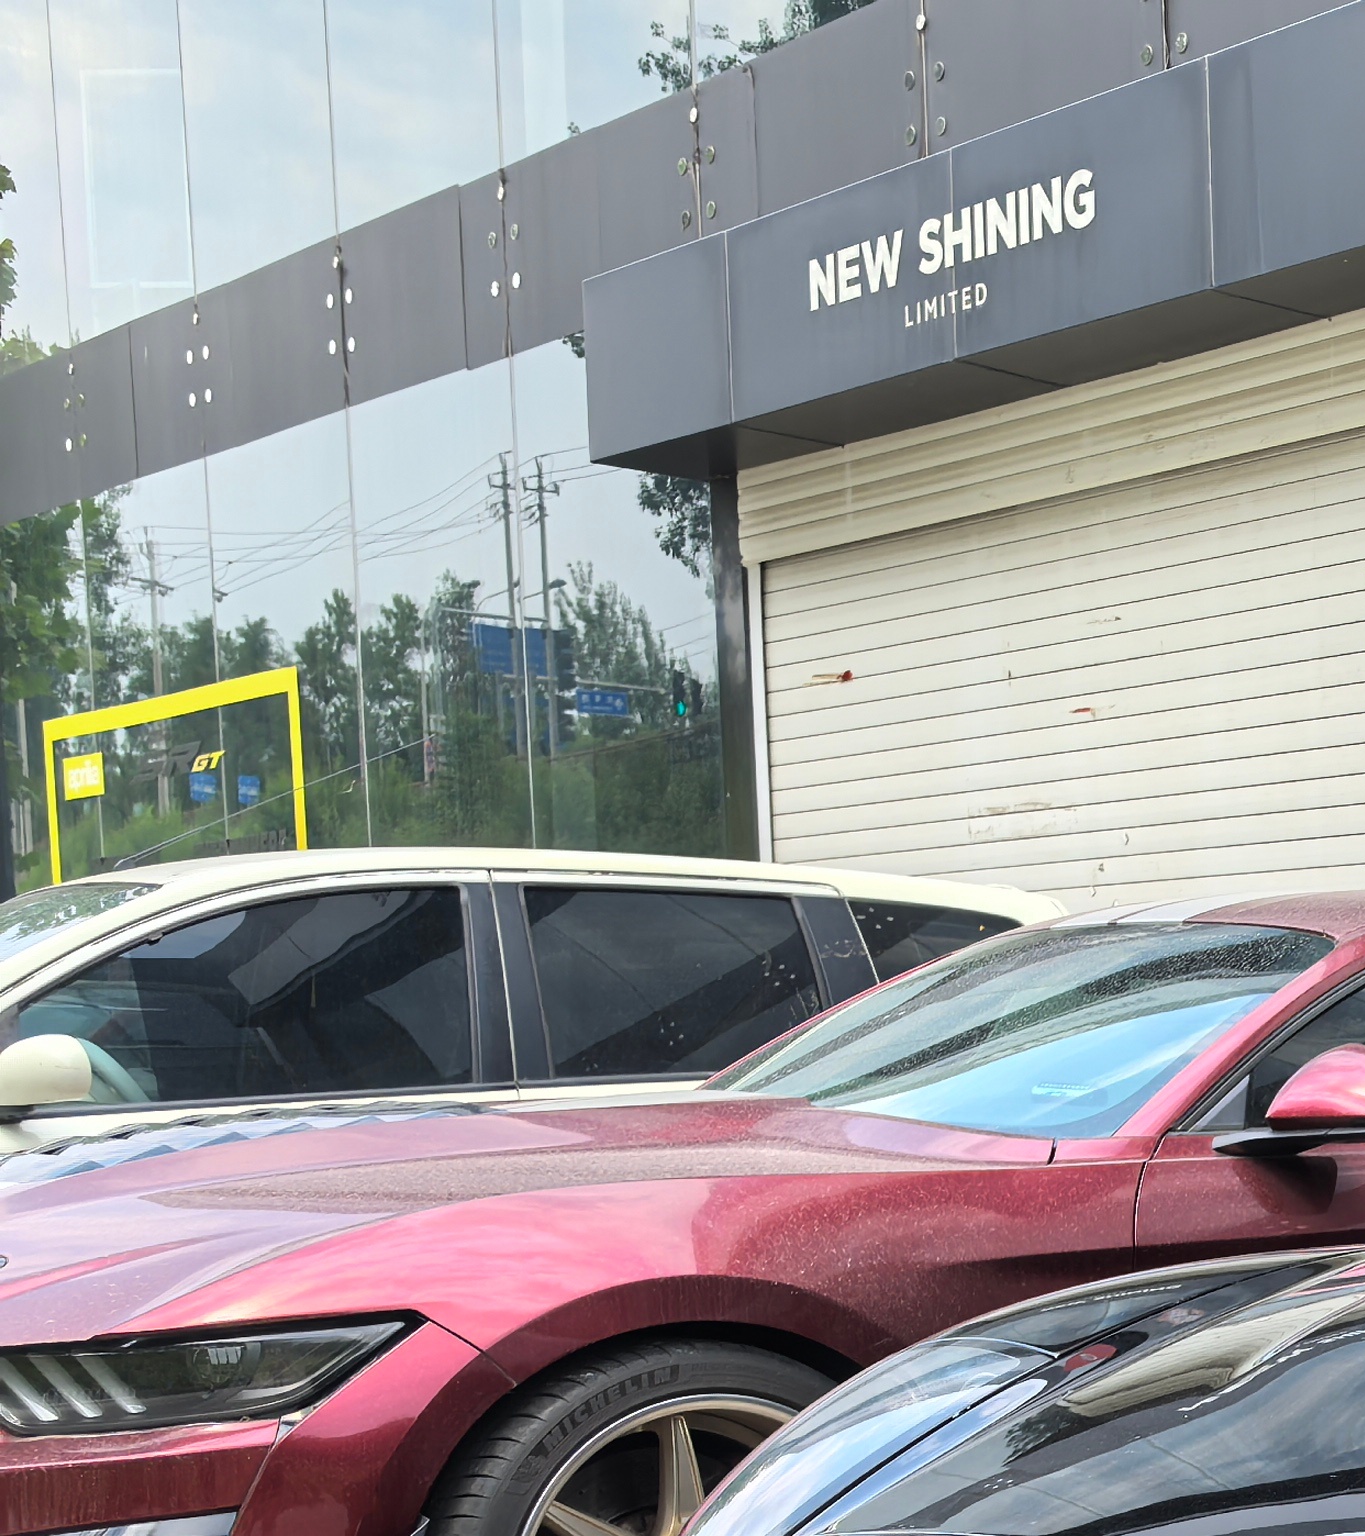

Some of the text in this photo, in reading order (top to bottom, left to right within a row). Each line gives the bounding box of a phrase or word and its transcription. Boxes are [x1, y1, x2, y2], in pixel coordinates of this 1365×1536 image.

[808, 168, 1096, 312] NEW SHINING
[904, 282, 988, 328] LIMITED
[191, 749, 226, 773] GT
[542, 1367, 674, 1451] MICHELIN
